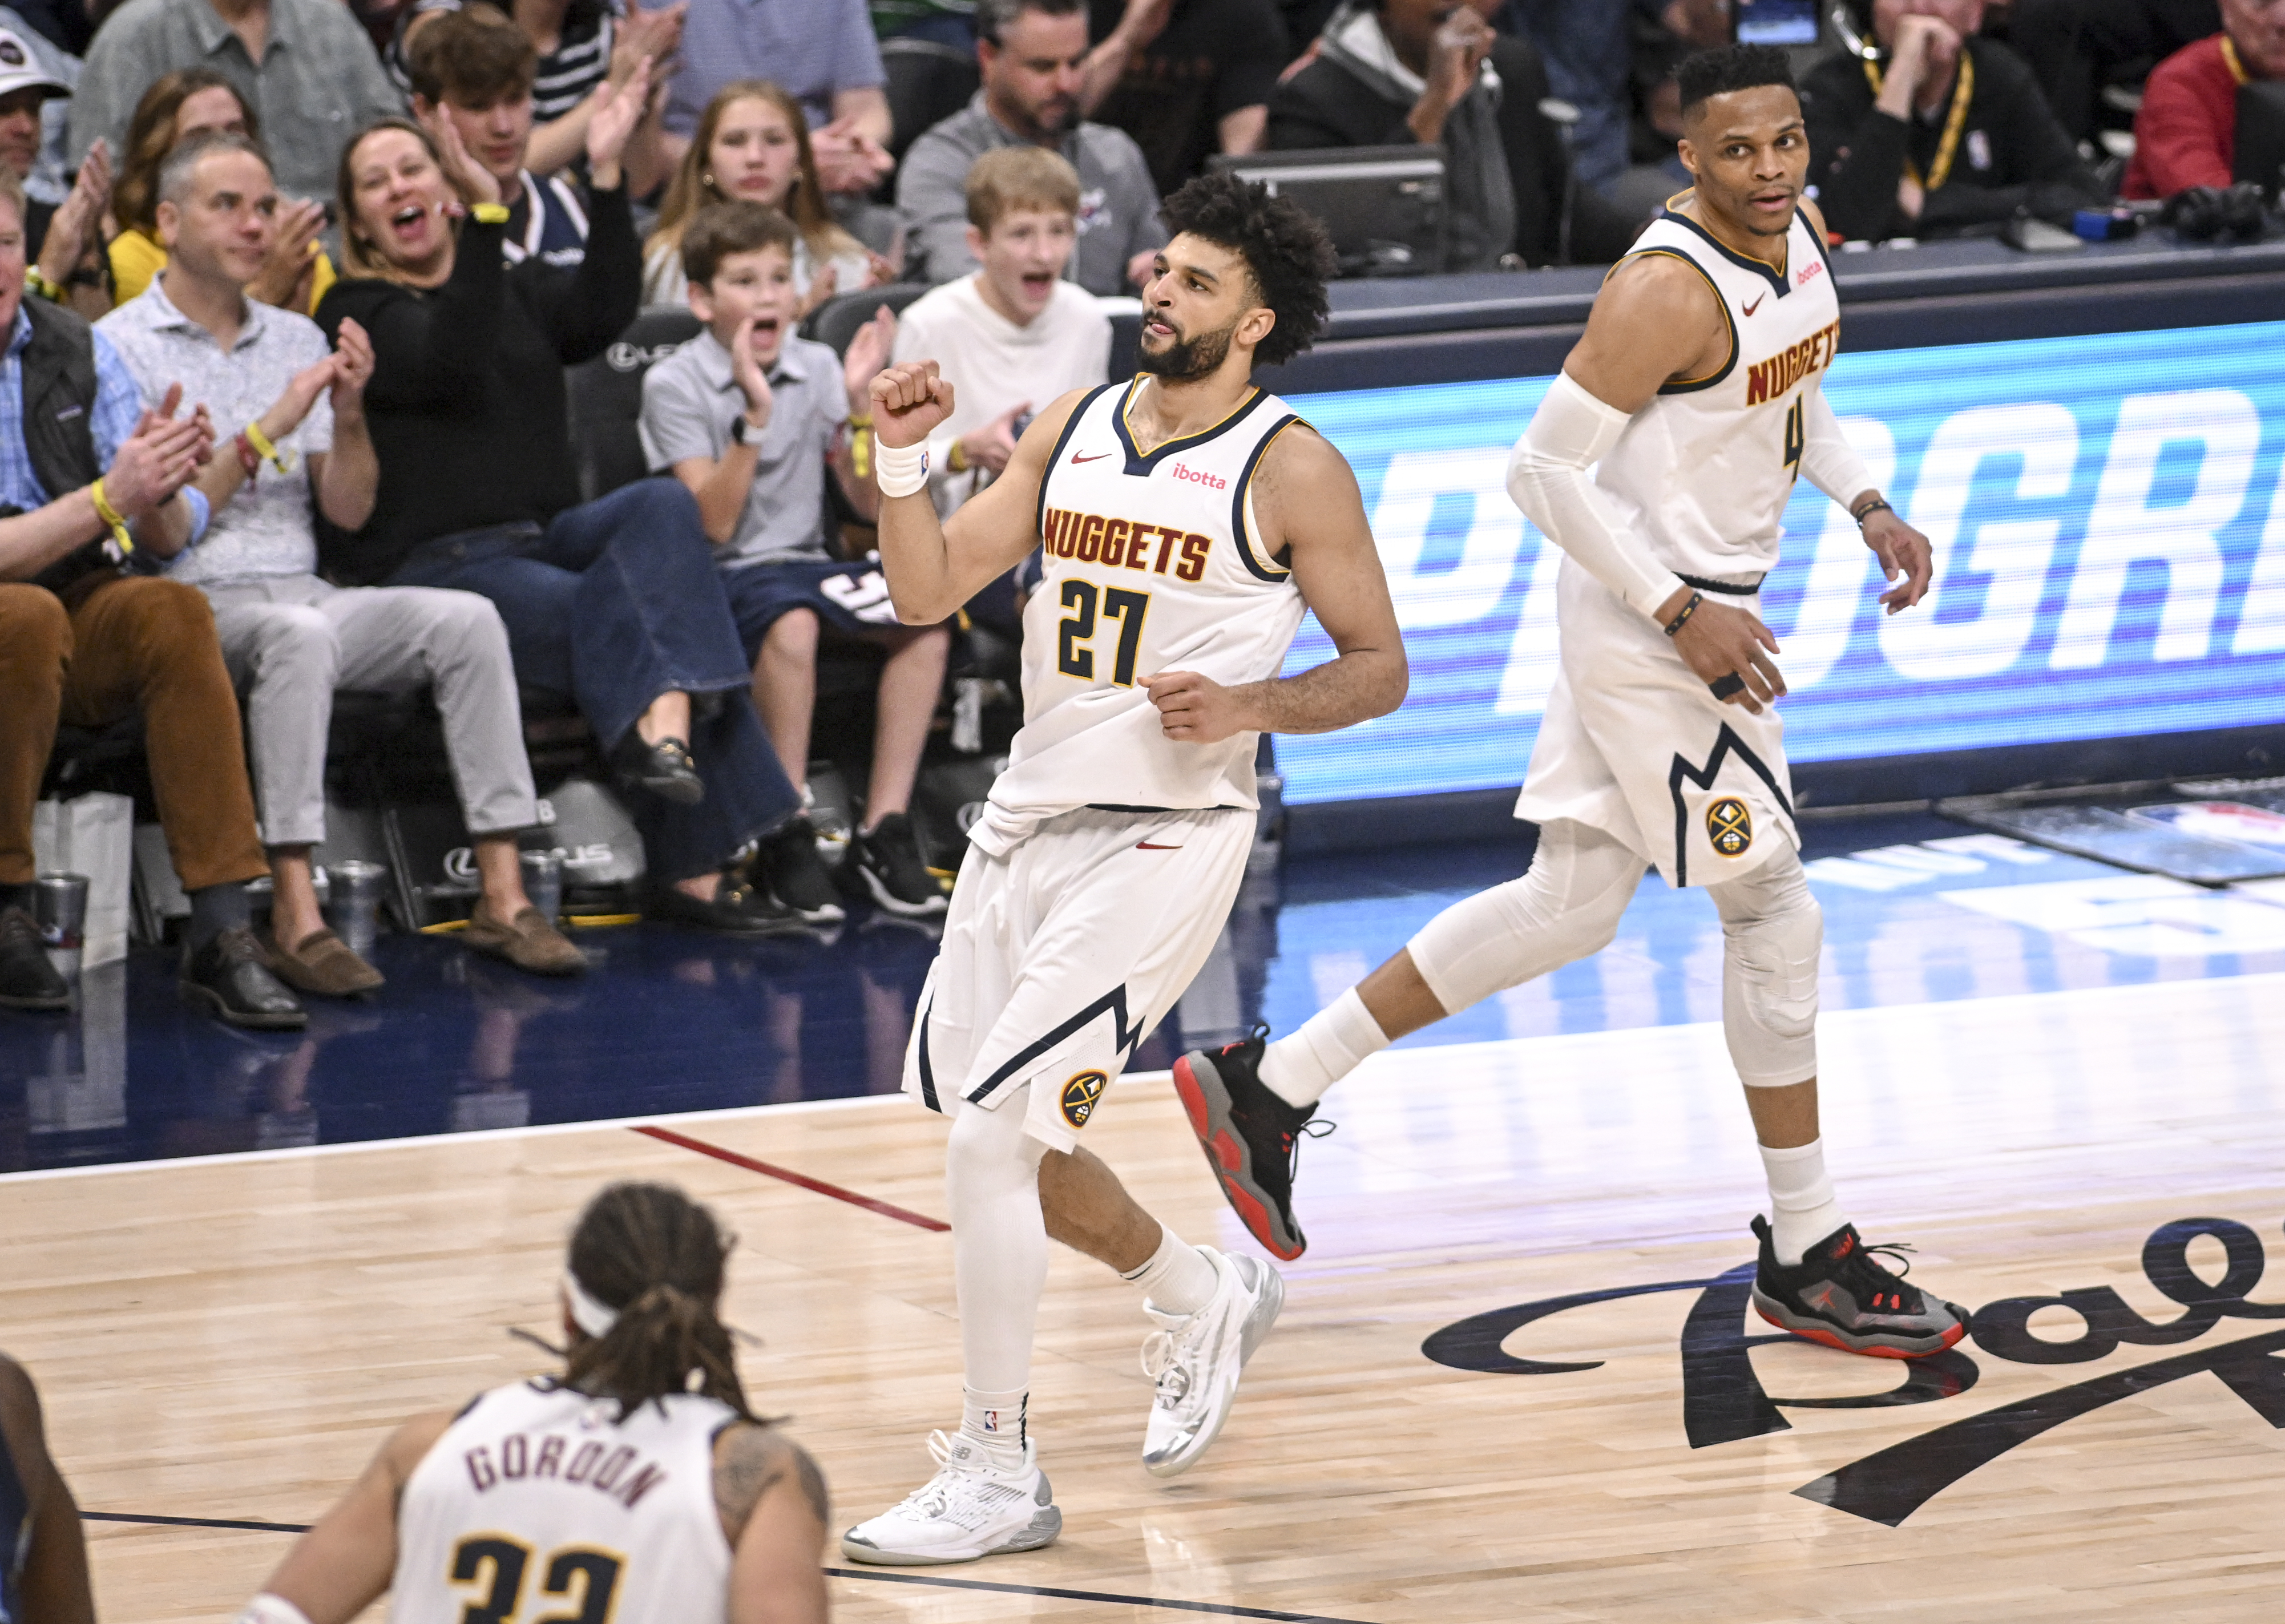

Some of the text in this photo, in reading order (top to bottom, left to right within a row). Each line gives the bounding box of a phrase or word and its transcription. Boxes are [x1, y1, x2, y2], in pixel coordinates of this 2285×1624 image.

[1172, 462, 1226, 490] ibotta
[1783, 390, 1805, 486] 4
[1044, 507, 1213, 583] NUGGETS
[1057, 577, 1152, 689] 27
[1421, 1217, 2285, 1449] Bal
[465, 1432, 669, 1512] GORDON
